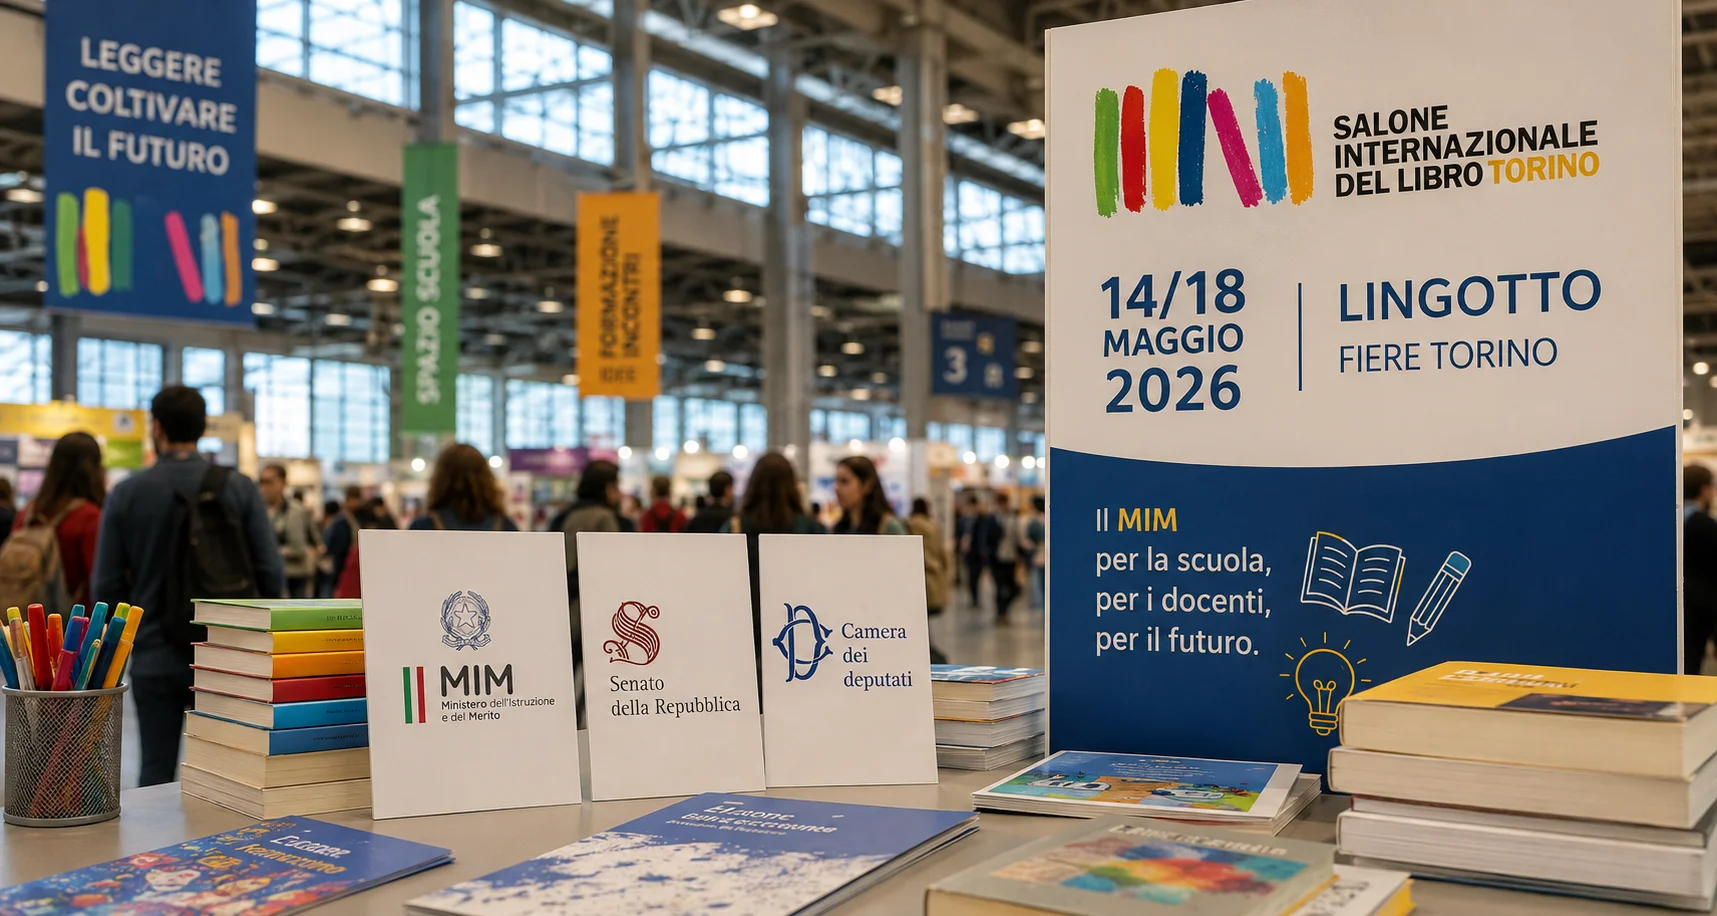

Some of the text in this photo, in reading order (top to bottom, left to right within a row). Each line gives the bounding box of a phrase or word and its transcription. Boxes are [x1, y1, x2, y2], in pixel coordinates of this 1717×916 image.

[81, 36, 222, 88] LEGGERE
[66, 79, 237, 134] COLTIVARE
[1333, 104, 1449, 140] SALONE
[73, 125, 230, 176] IL FUTURO
[1335, 119, 1599, 169] INTERNAZIONALE
[1336, 151, 1600, 198] DEL LIBRO TORINO
[415, 194, 441, 405] SPAZIO SCUOLA
[1100, 268, 1247, 320] 14/18
[1339, 269, 1602, 323] LINGOTTO
[1102, 322, 1245, 358] MAGGIO
[1339, 337, 1559, 375] FIERE TORINO
[943, 346, 968, 384] 3
[1104, 363, 1243, 415] 2026
[1096, 507, 1178, 532] Il MIM
[1096, 545, 1272, 577] per la scuola,
[1096, 585, 1272, 618] per i docenti,
[840, 622, 908, 640] Camera
[1096, 626, 1260, 657] per il futuro.
[842, 646, 869, 664] dei
[440, 664, 514, 697] MIM
[609, 675, 665, 692] Senato
[843, 670, 913, 692] deputati
[441, 697, 556, 711] Ministero dell'Istruzione
[441, 710, 501, 722] e del Merito
[611, 696, 741, 719] della Repubblica
